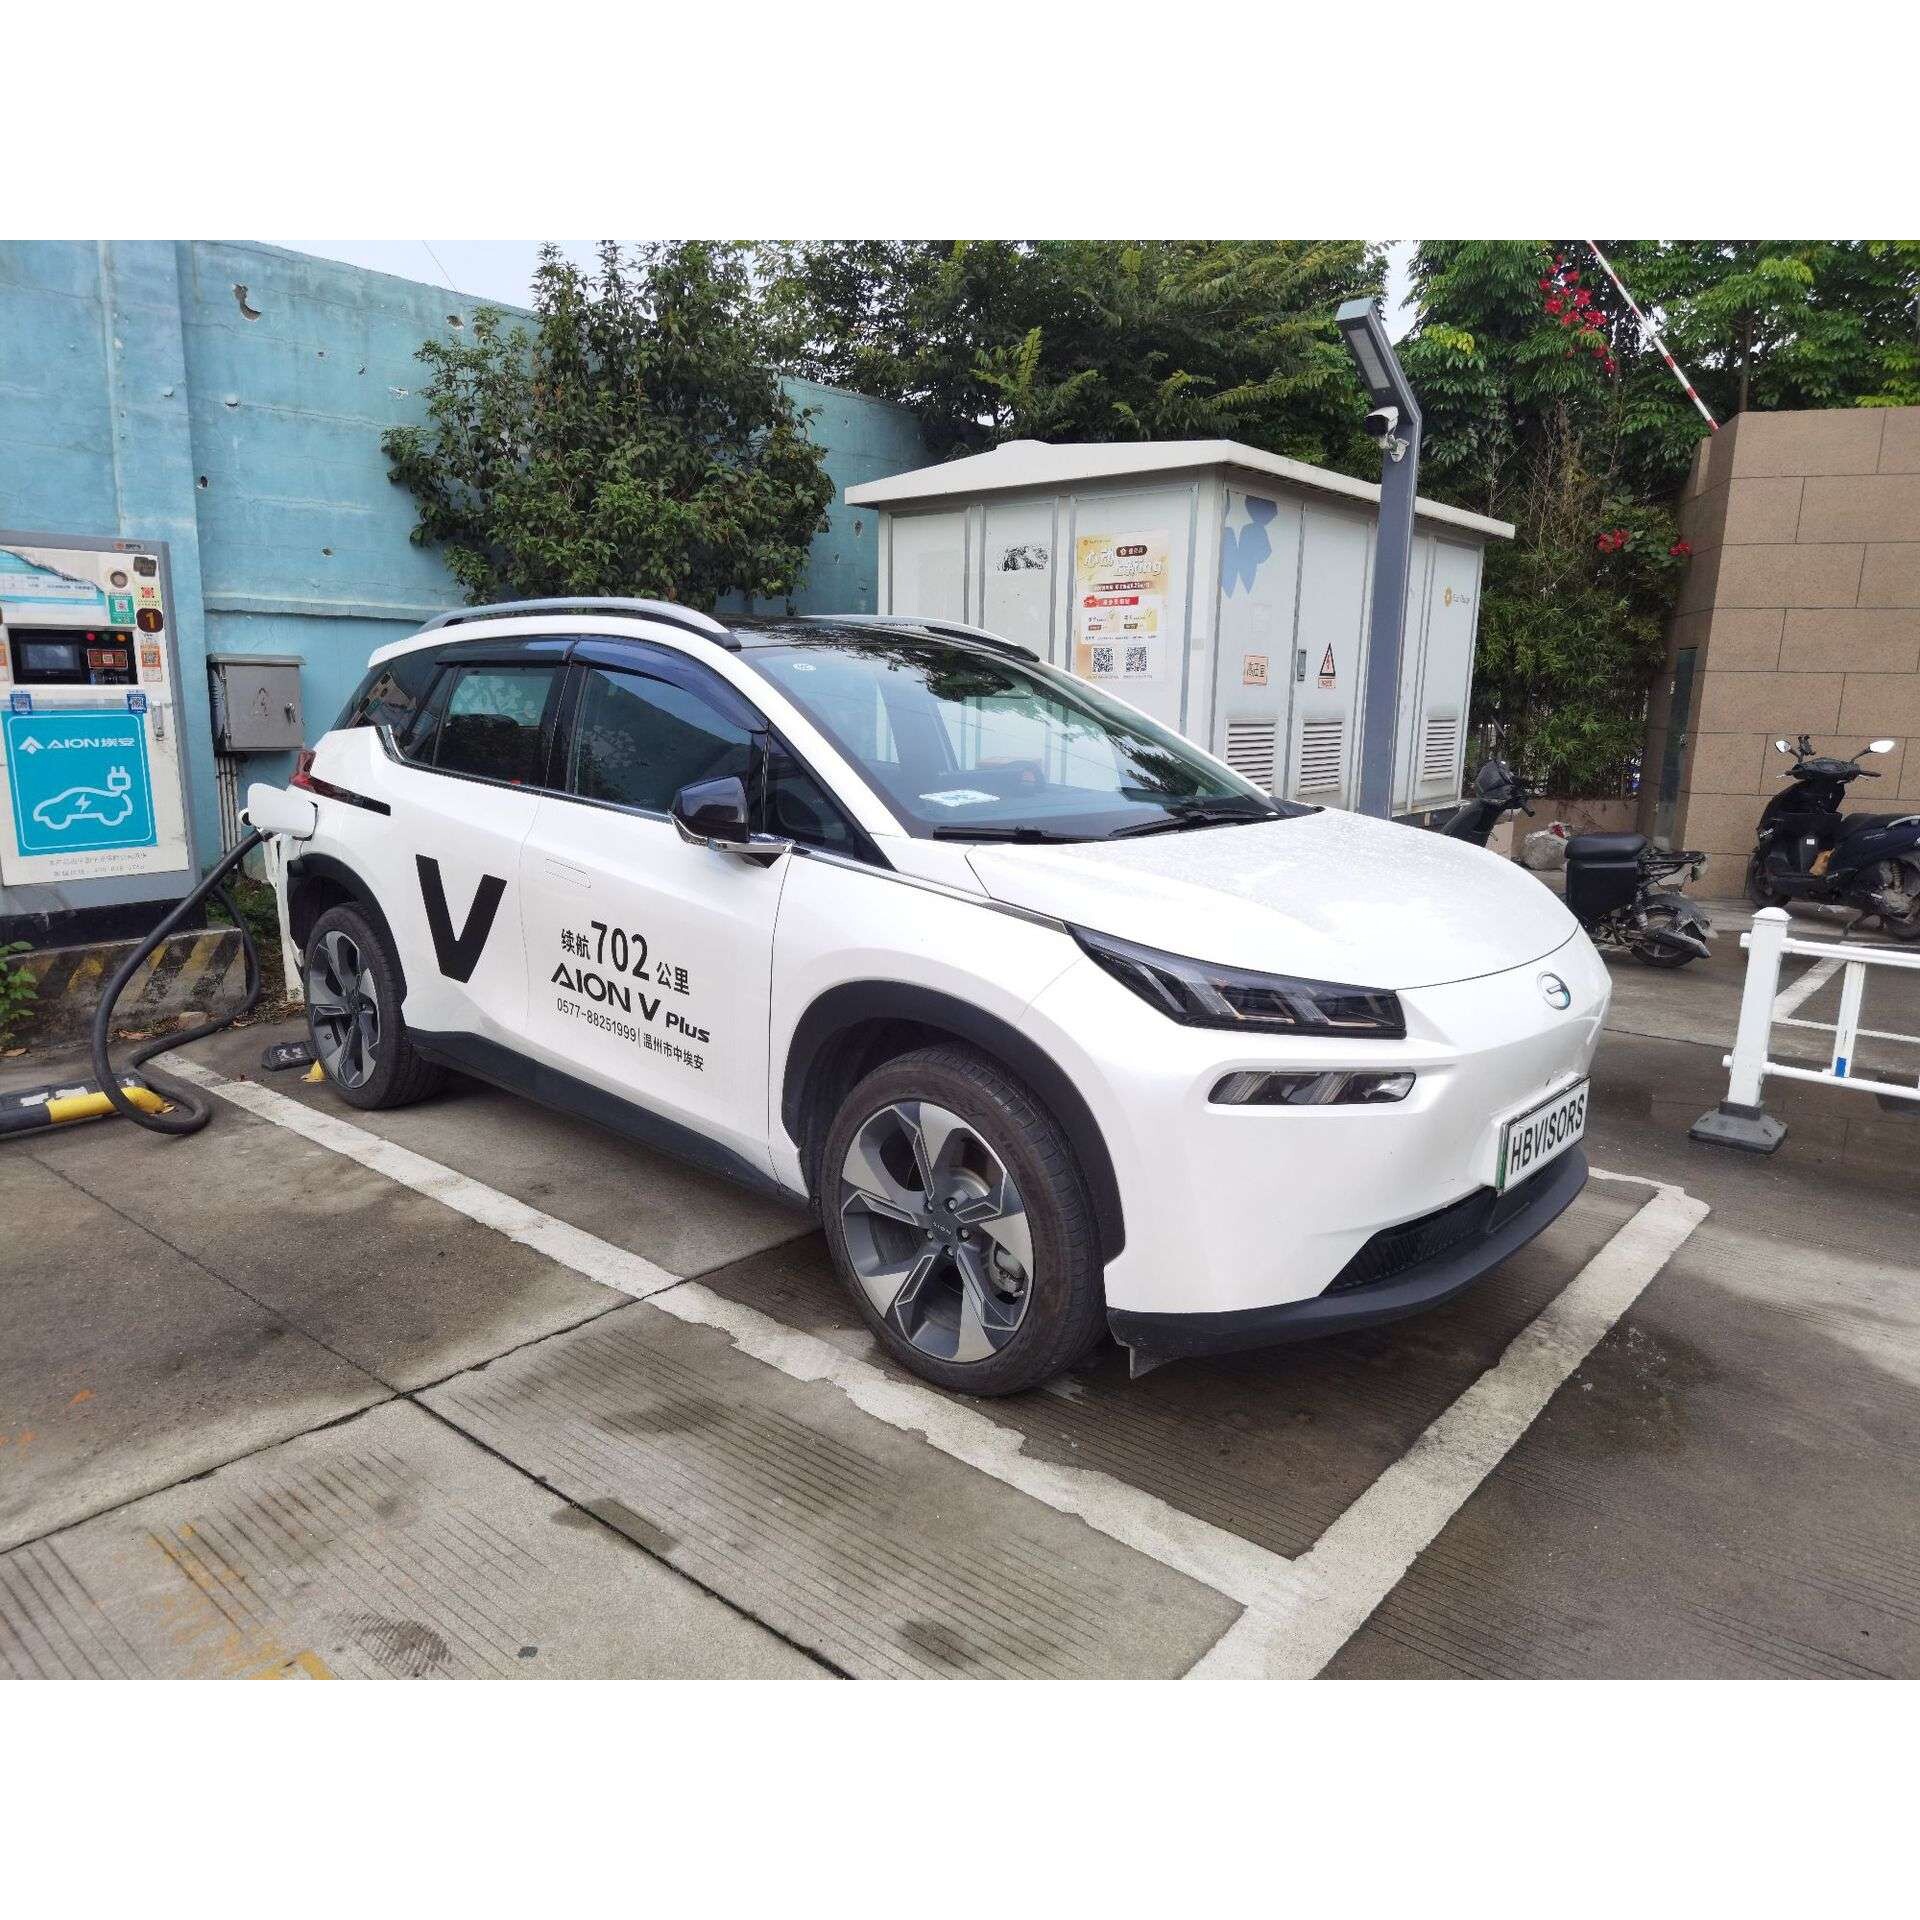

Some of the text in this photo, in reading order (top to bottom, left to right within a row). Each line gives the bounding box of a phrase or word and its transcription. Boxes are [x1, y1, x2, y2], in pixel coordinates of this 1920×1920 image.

[415, 853, 507, 984] V
[591, 920, 650, 981] 702
[656, 961, 690, 996] 公里
[551, 962, 711, 1043] AION V Plus
[557, 997, 637, 1042] 0577-88251999
[1510, 1093, 1585, 1175] HBVISORS
